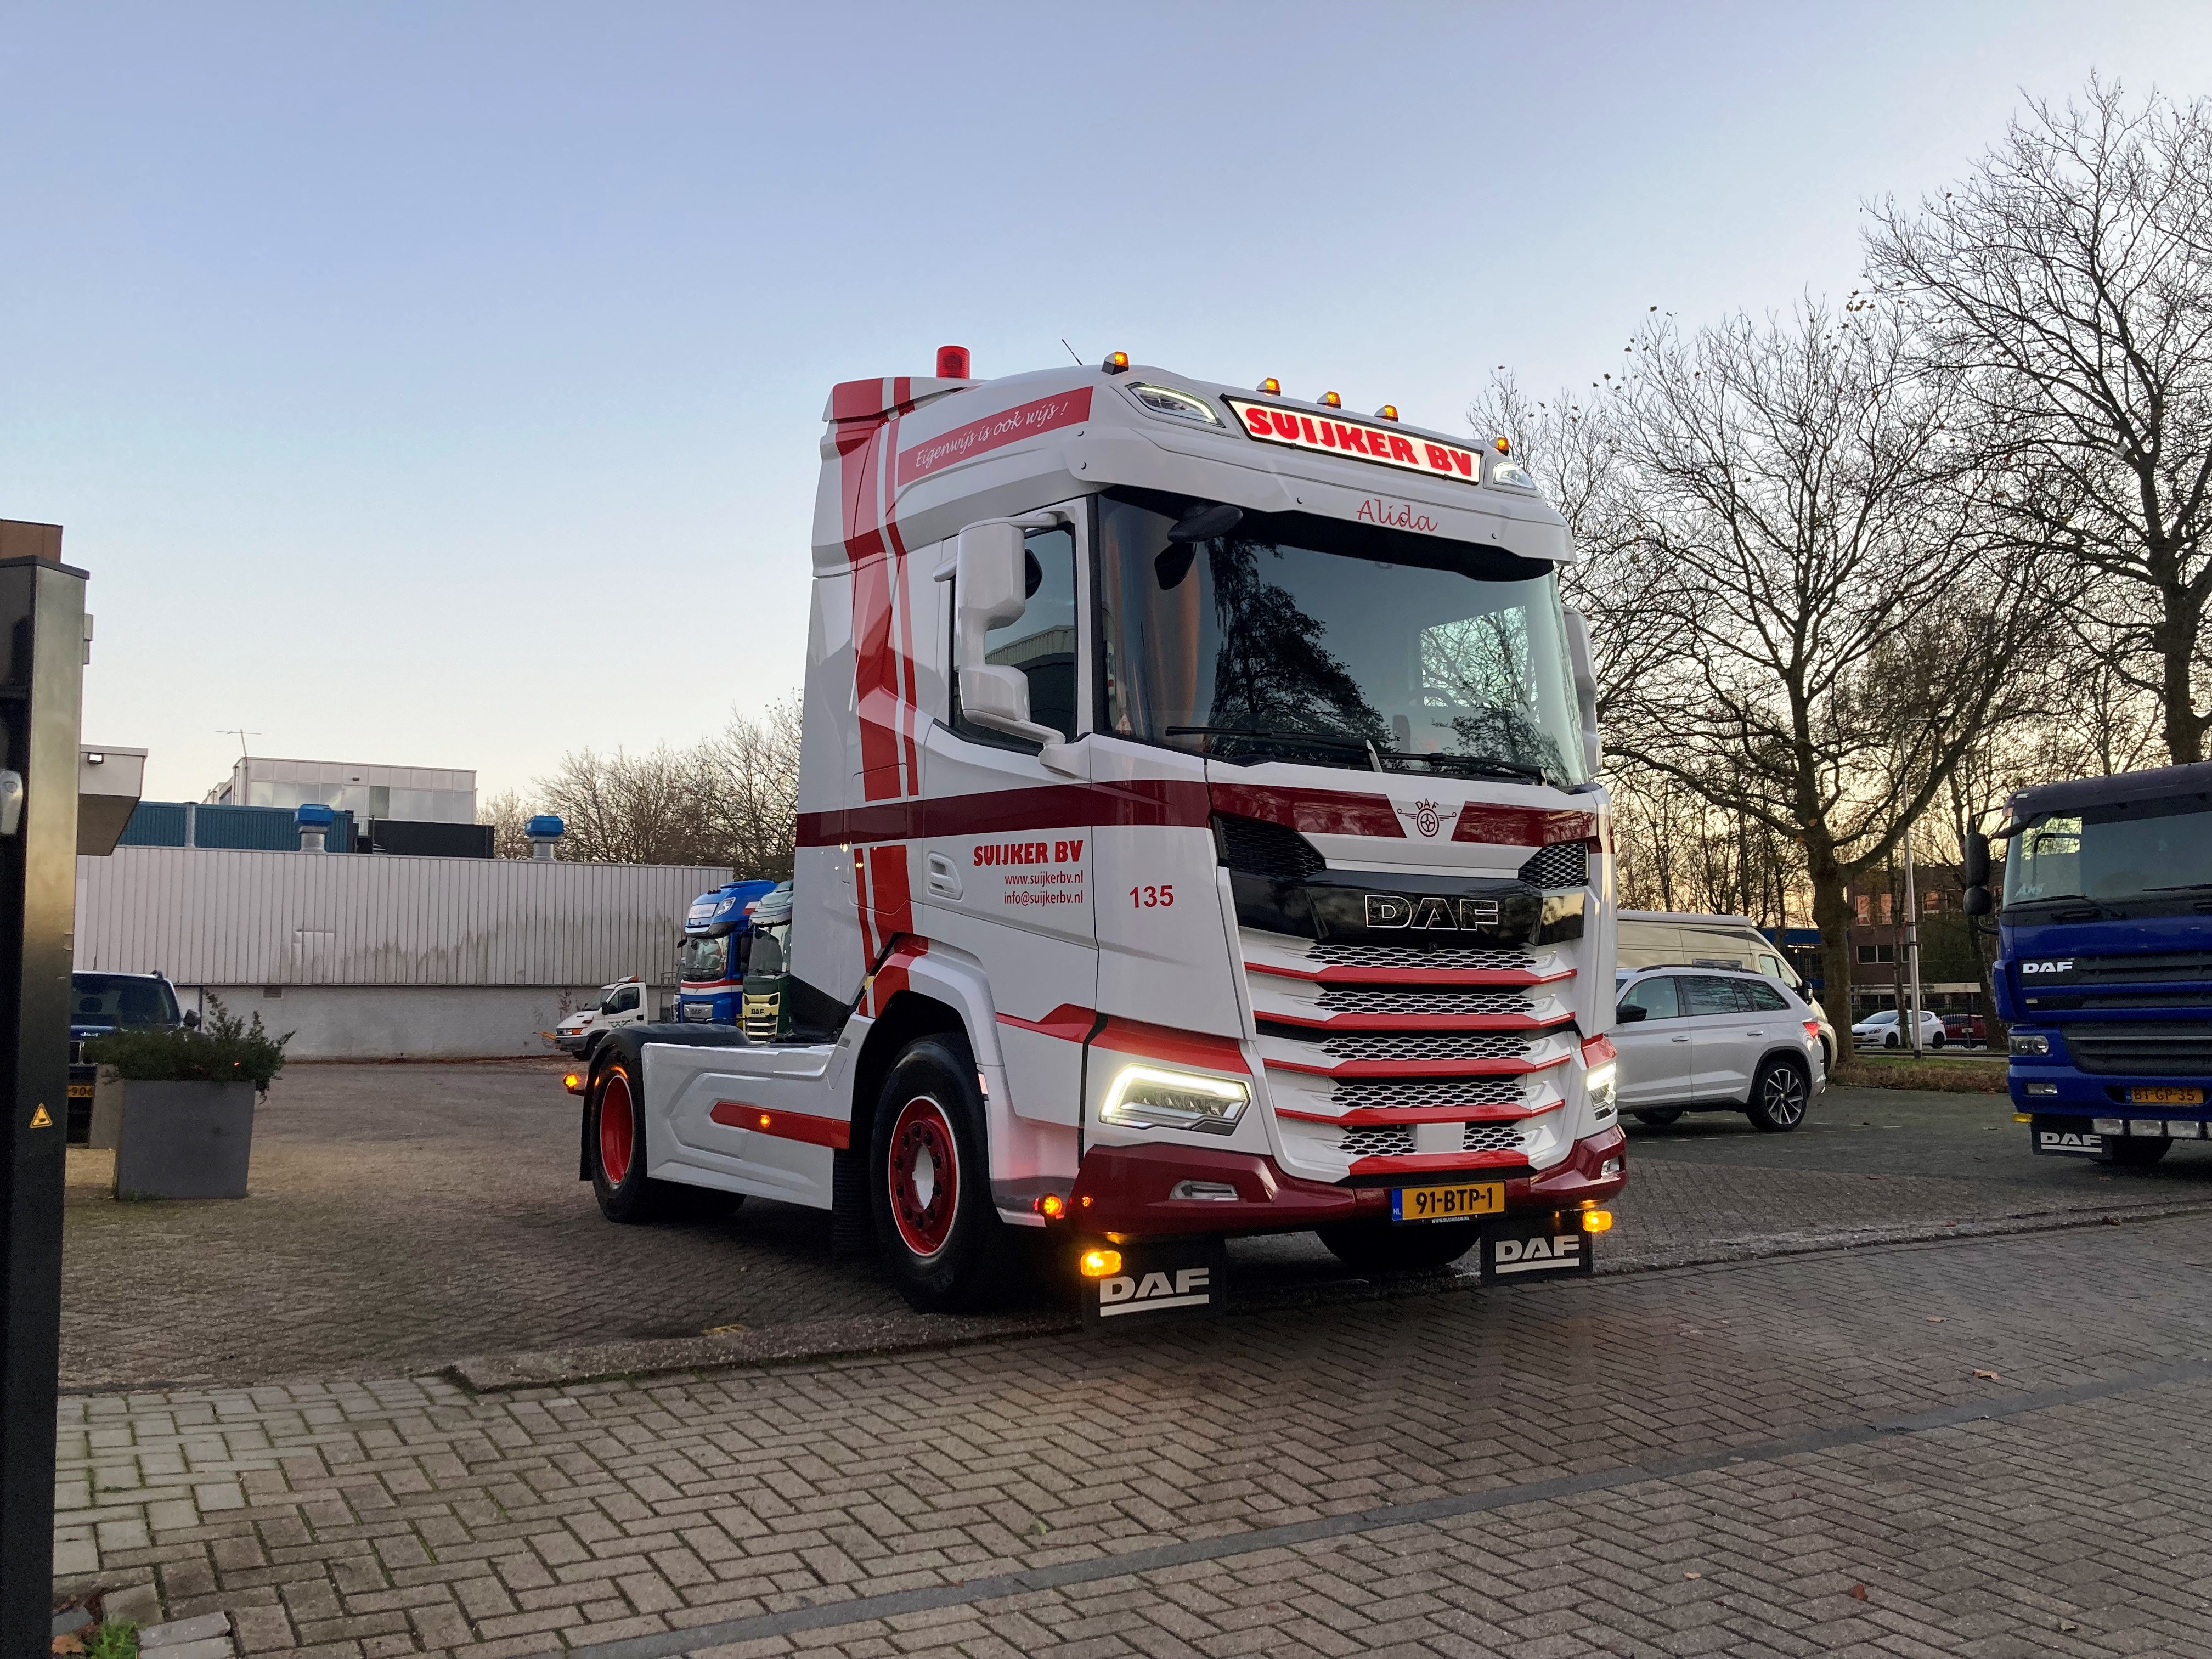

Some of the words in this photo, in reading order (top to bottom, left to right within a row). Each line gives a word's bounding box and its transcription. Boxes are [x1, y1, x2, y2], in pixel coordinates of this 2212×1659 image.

[978, 424, 992, 442] is
[993, 411, 1024, 436] ook
[1245, 408, 1419, 465] SUIJKER
[1424, 443, 1472, 477] BV
[1357, 498, 1438, 532] Alida
[1415, 798, 1440, 810] DAF
[973, 842, 1048, 866] SUIJKER
[1054, 840, 1084, 863] BV
[1005, 870, 1084, 887] www.suijkerbv.nl
[1003, 890, 1084, 907] info@suijkerbv.nl
[1130, 885, 1174, 909] 135
[1364, 894, 1499, 932] DAF
[2023, 961, 2073, 974] DAF
[2134, 1088, 2195, 1101] BT-GP-35
[2040, 1132, 2102, 1146] DAF
[1416, 1187, 1493, 1214] 91-BTP-1
[1495, 1235, 1579, 1262] DAF
[1099, 1267, 1209, 1304] DAF
